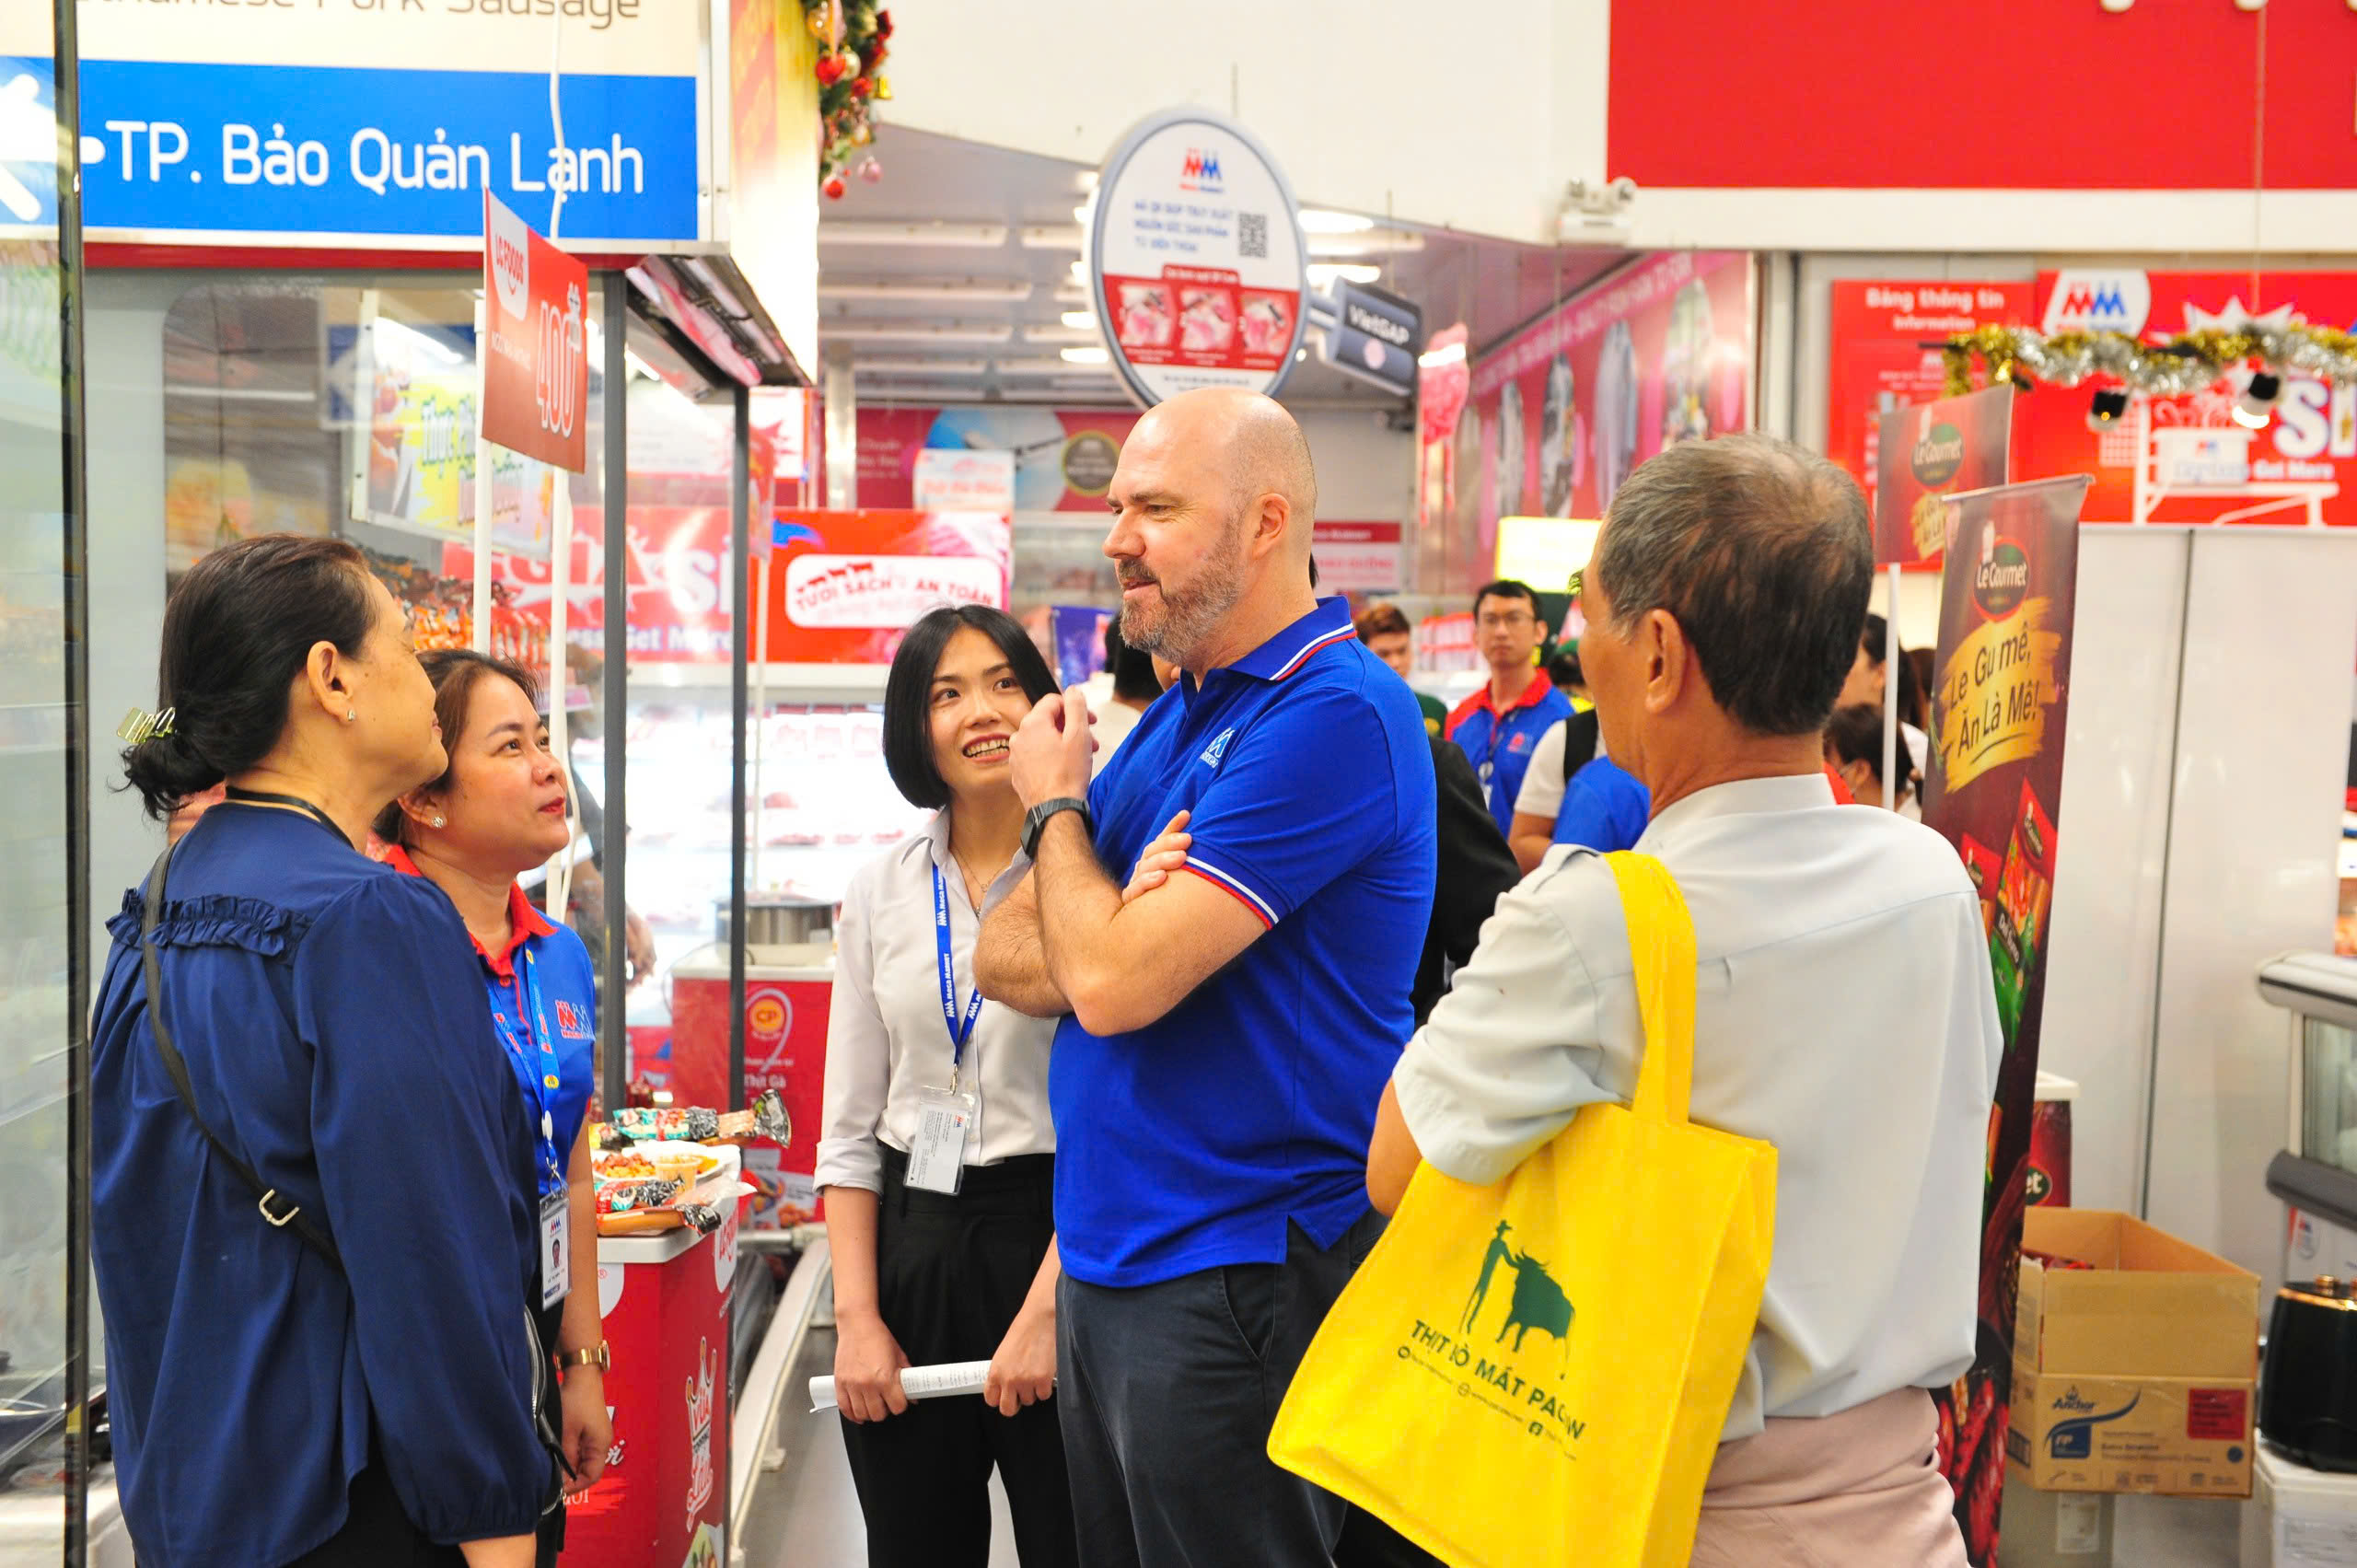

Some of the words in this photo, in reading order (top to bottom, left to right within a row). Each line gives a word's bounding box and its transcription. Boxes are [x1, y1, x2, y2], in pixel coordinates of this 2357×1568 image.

[105, 120, 202, 183] TP.
[222, 122, 330, 186] Bảo
[350, 126, 490, 195] Quản
[511, 132, 644, 202] Lạnh
[1989, 561, 2027, 588] Gourmet
[1950, 670, 1968, 710] Le
[1975, 645, 1996, 688] Gu
[1957, 707, 1980, 759] Ăn
[1983, 691, 2002, 738] Là
[2006, 679, 2040, 726] Mê!
[1411, 1319, 1451, 1354] THỊT
[1474, 1358, 1527, 1397] MÁT
[2051, 1397, 2096, 1411] Anchor
